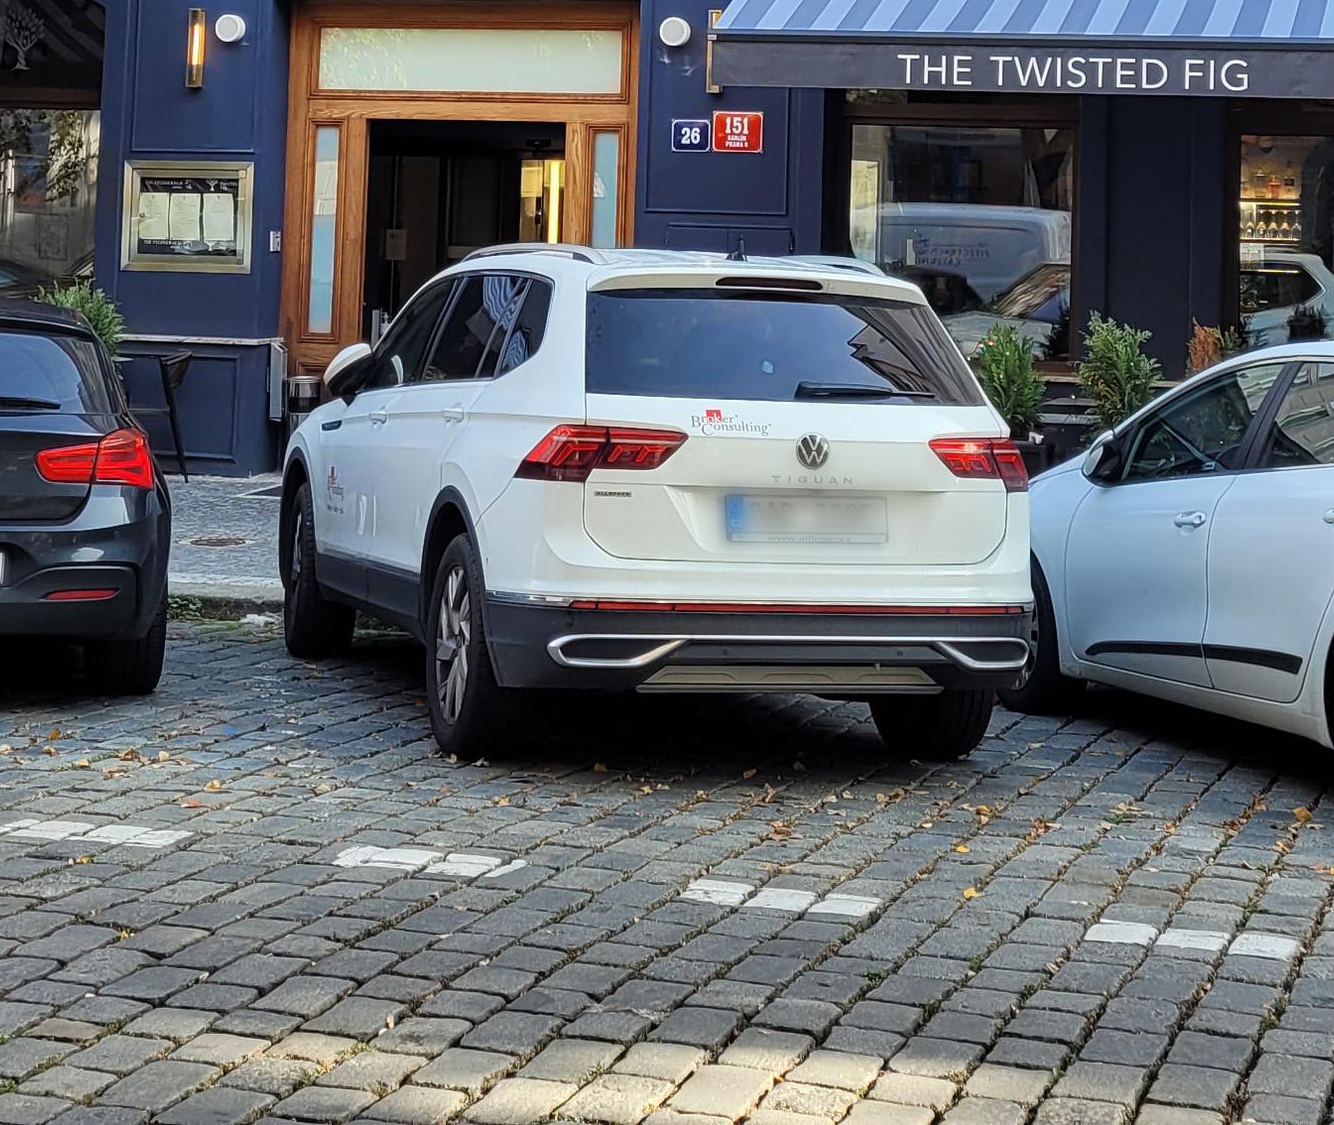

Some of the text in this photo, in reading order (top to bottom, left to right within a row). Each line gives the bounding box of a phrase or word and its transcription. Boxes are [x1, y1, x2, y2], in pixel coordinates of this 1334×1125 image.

[897, 53, 1250, 92] THE TWISTED FIG
[725, 116, 749, 135] 151
[681, 127, 701, 145] 26
[701, 420, 769, 436] Consulting
[771, 475, 854, 484] TIGUAN
